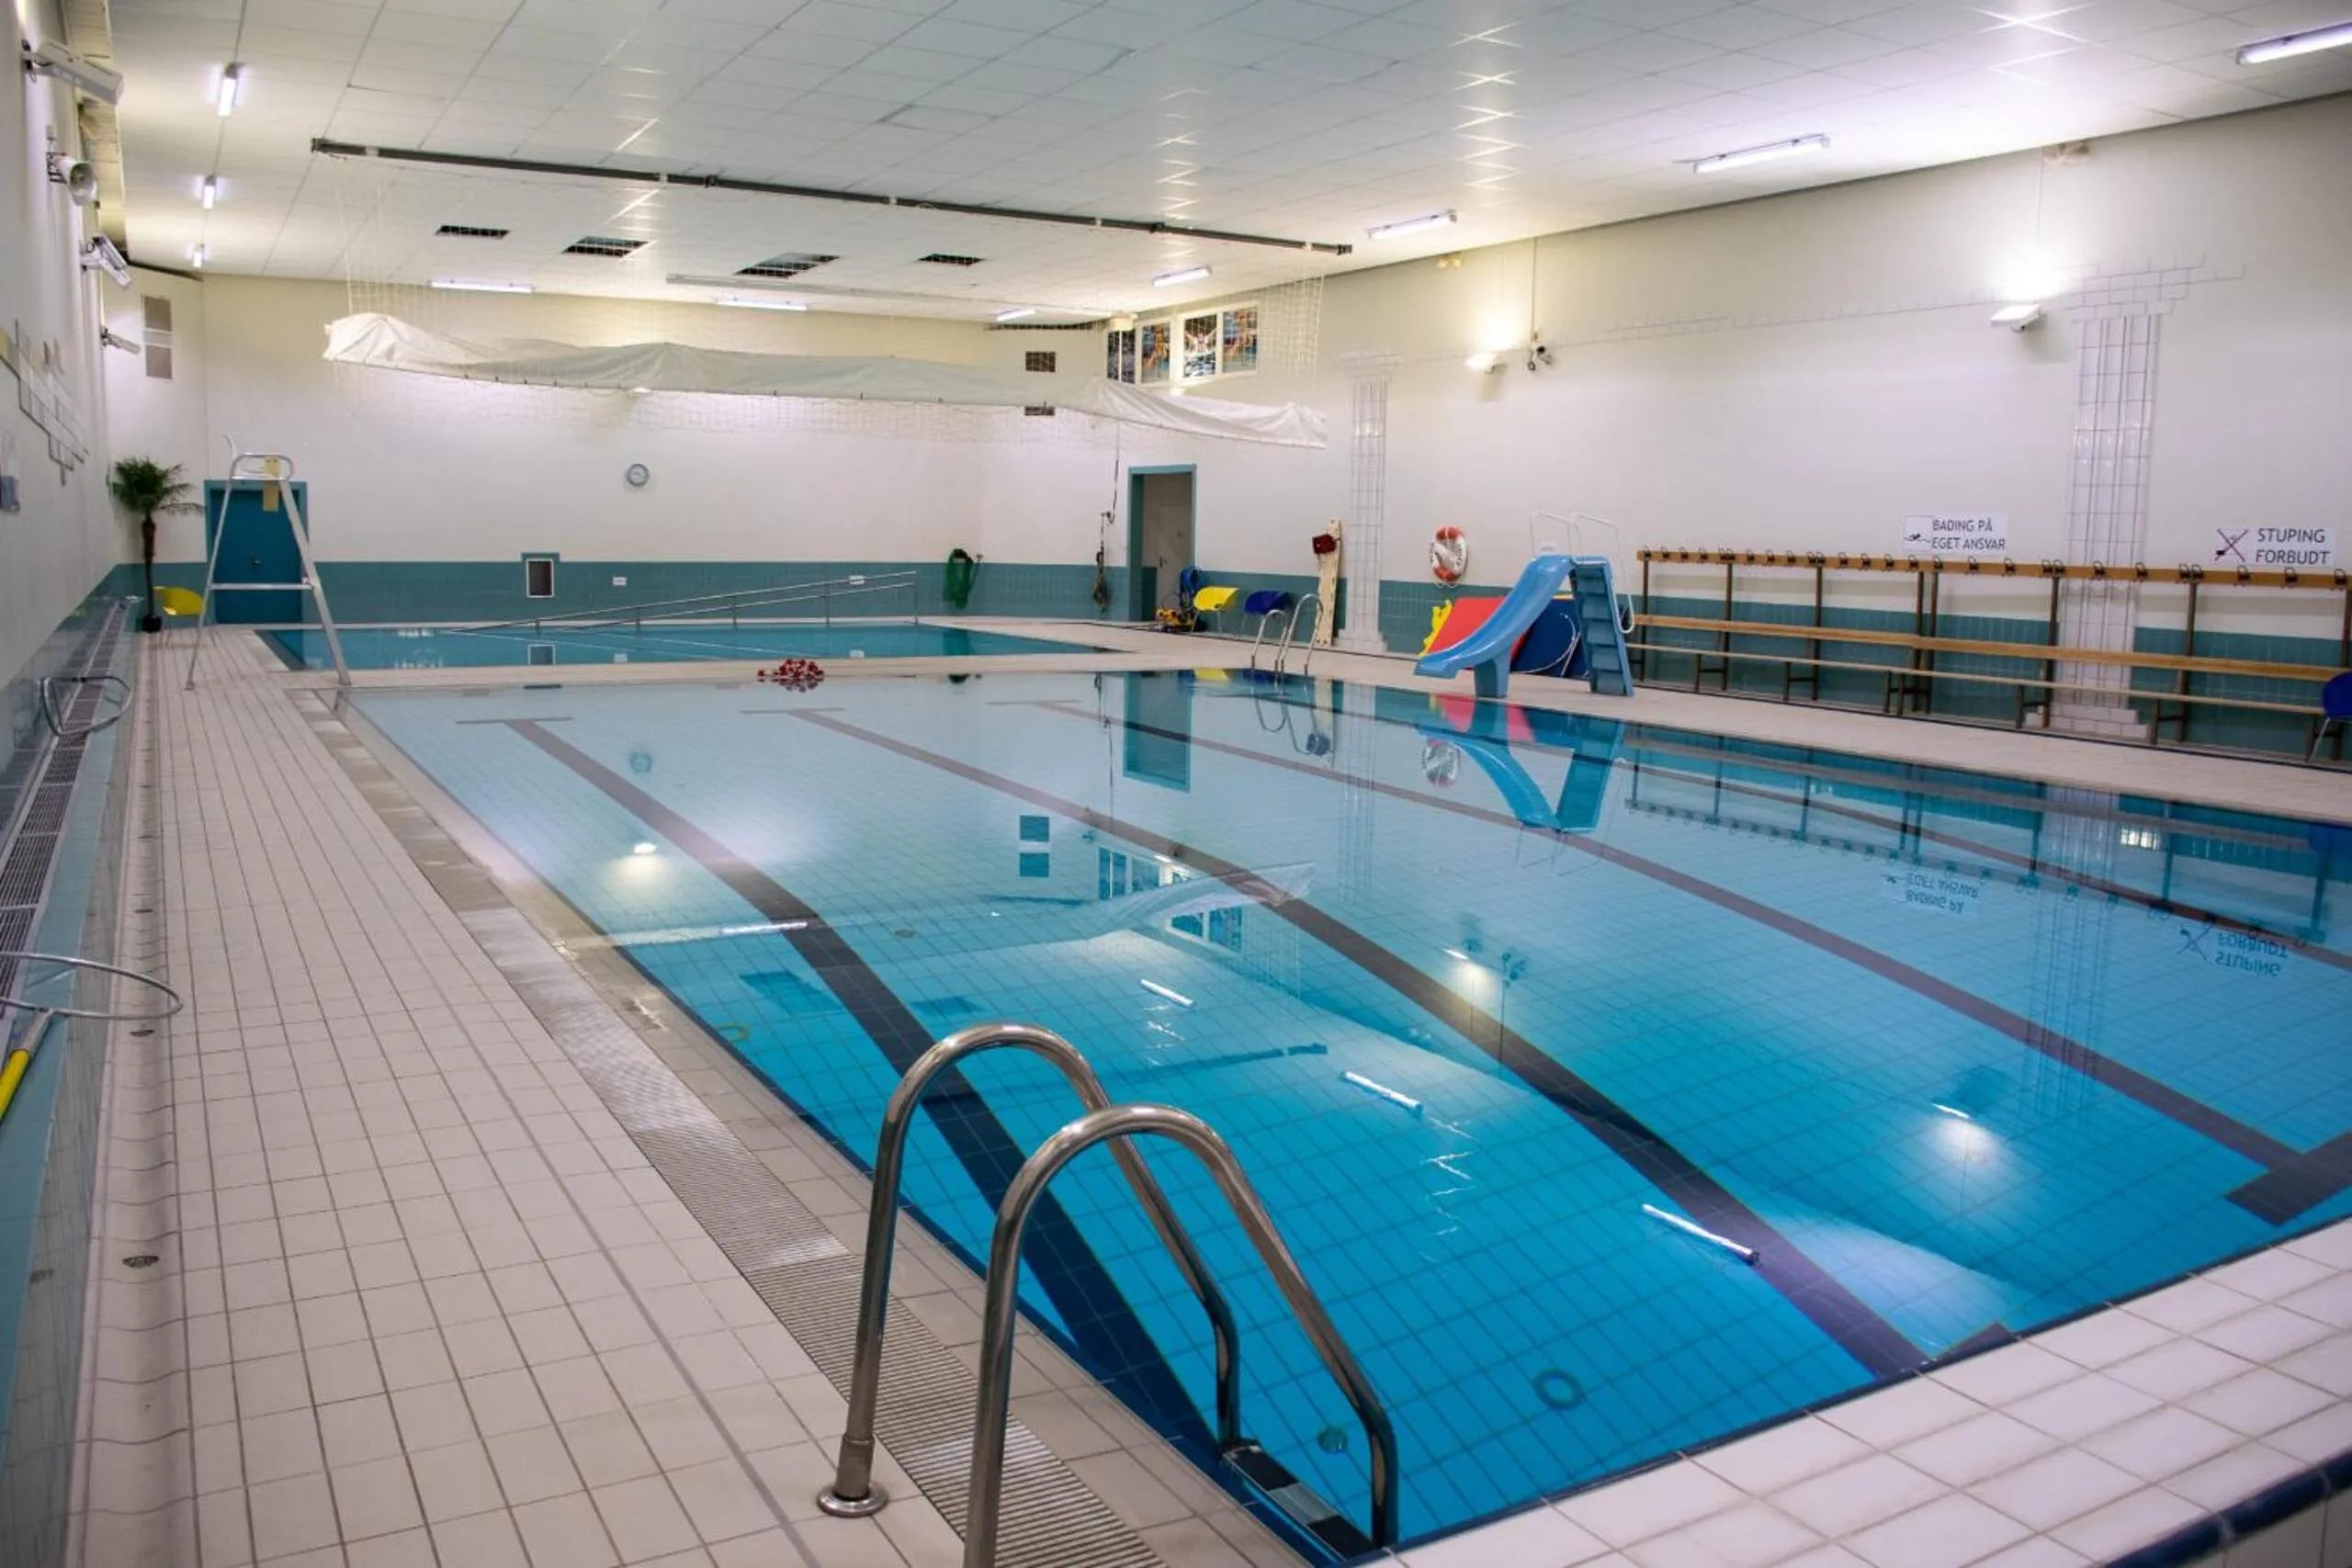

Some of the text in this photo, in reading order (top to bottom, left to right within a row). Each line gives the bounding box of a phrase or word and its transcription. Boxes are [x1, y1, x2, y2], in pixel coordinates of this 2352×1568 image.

[1932, 517, 1993, 532] BADING PÅ
[2257, 527, 2325, 543] STUPING
[1931, 536, 2007, 551] EGET ANSVAR
[2256, 549, 2331, 565] FORBUDT
